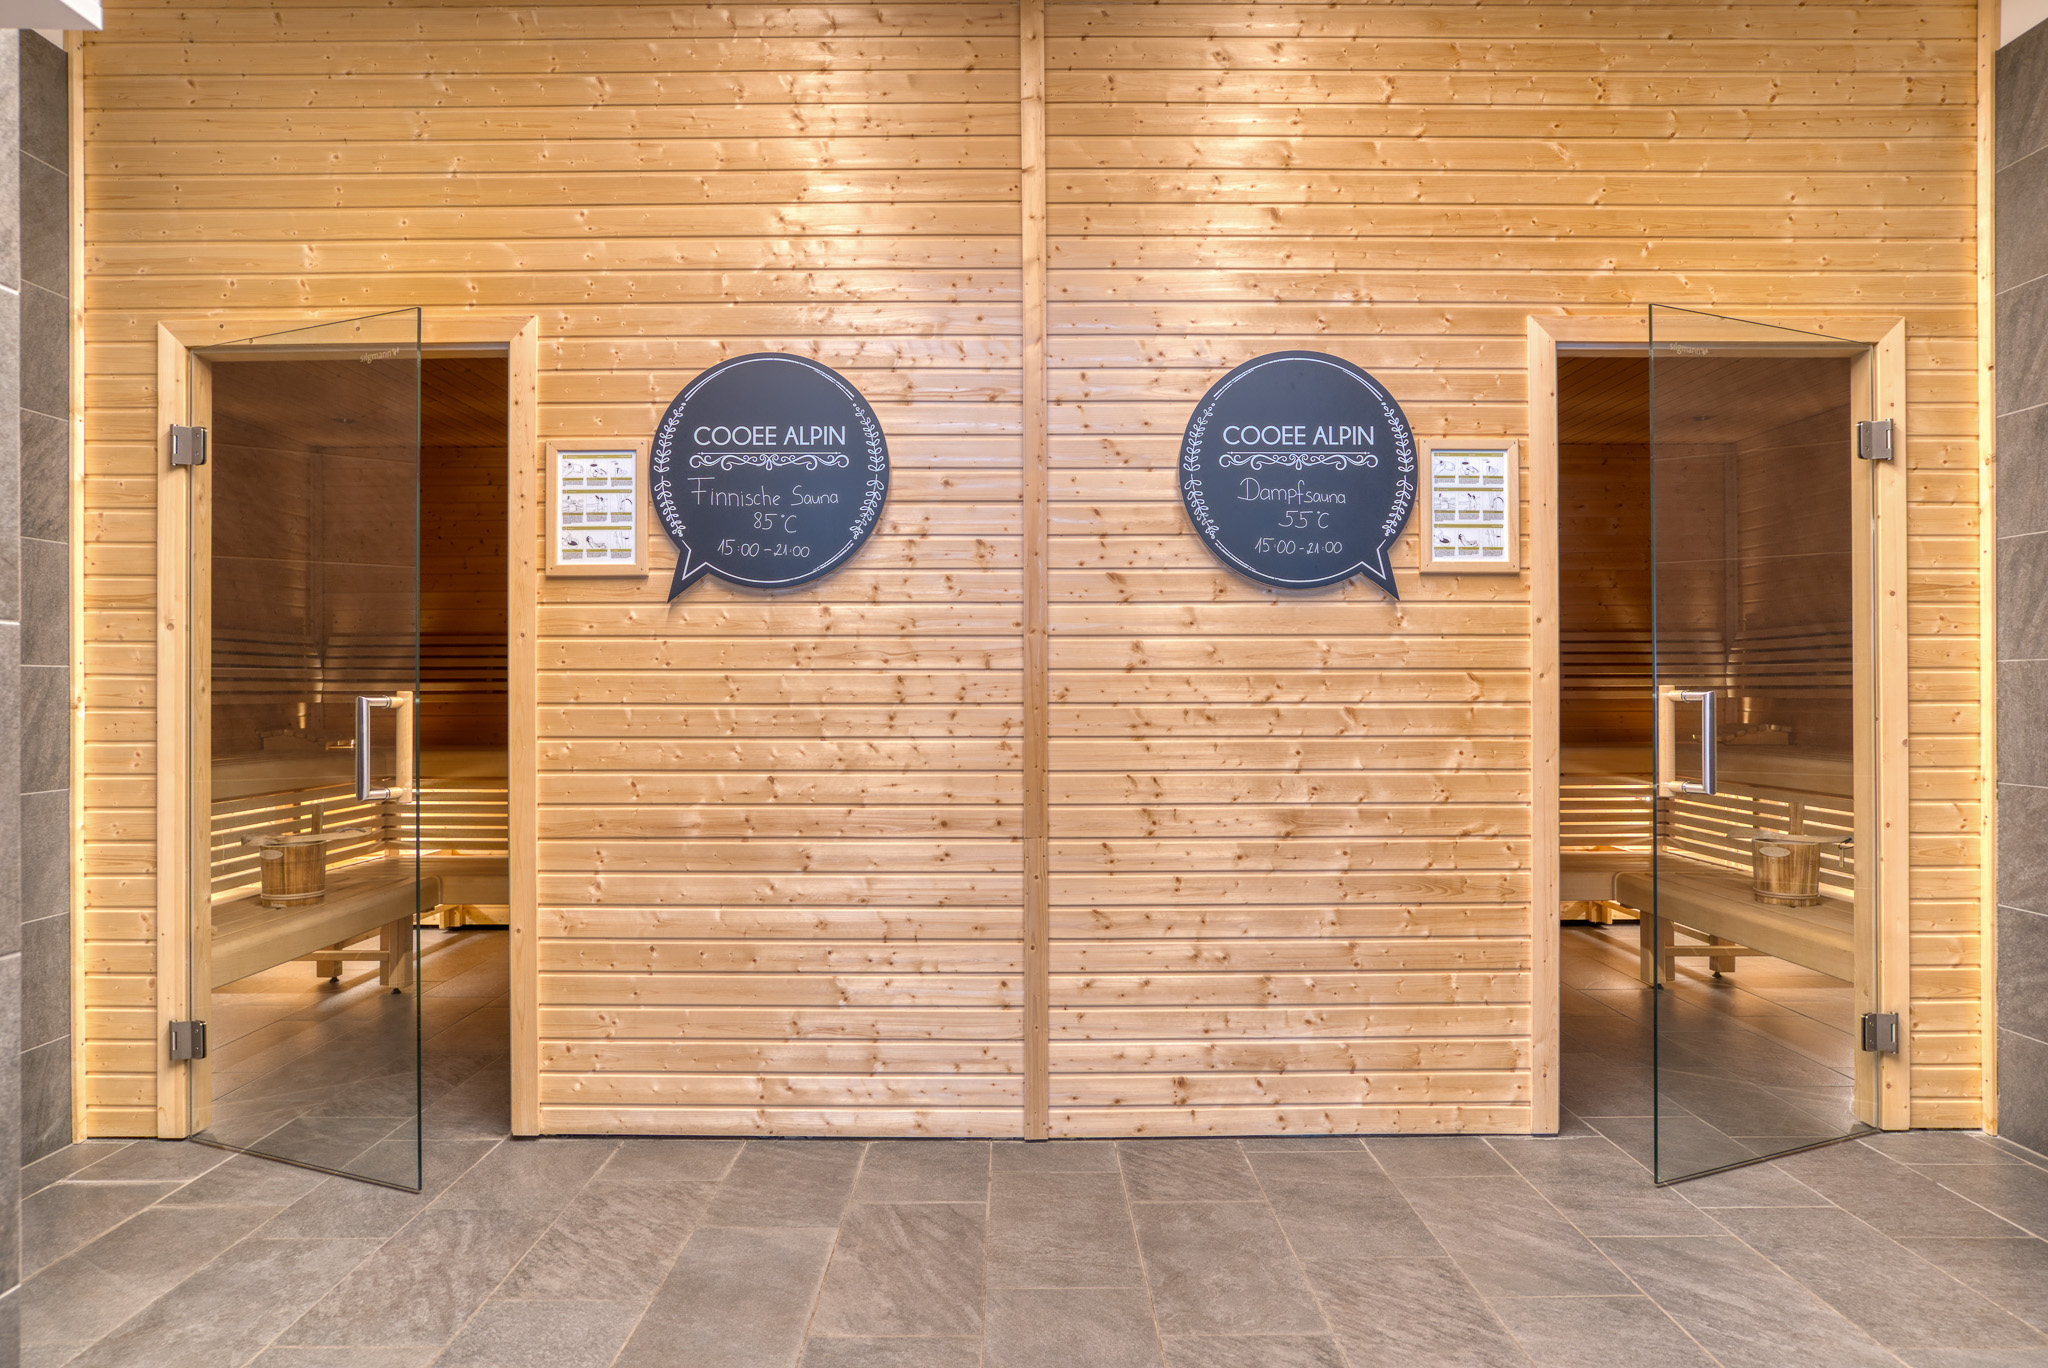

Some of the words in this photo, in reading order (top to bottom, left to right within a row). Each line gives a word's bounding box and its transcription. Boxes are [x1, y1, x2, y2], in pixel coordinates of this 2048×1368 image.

[360, 350, 392, 364] silgmann
[693, 426, 777, 446] COOEE
[783, 426, 846, 446] ALPIN
[1222, 425, 1306, 445] COOEE
[1312, 425, 1375, 445] ALPIN
[687, 476, 781, 507] Finnische
[790, 484, 839, 507] Sauna
[1237, 477, 1347, 505] Dampfsauna
